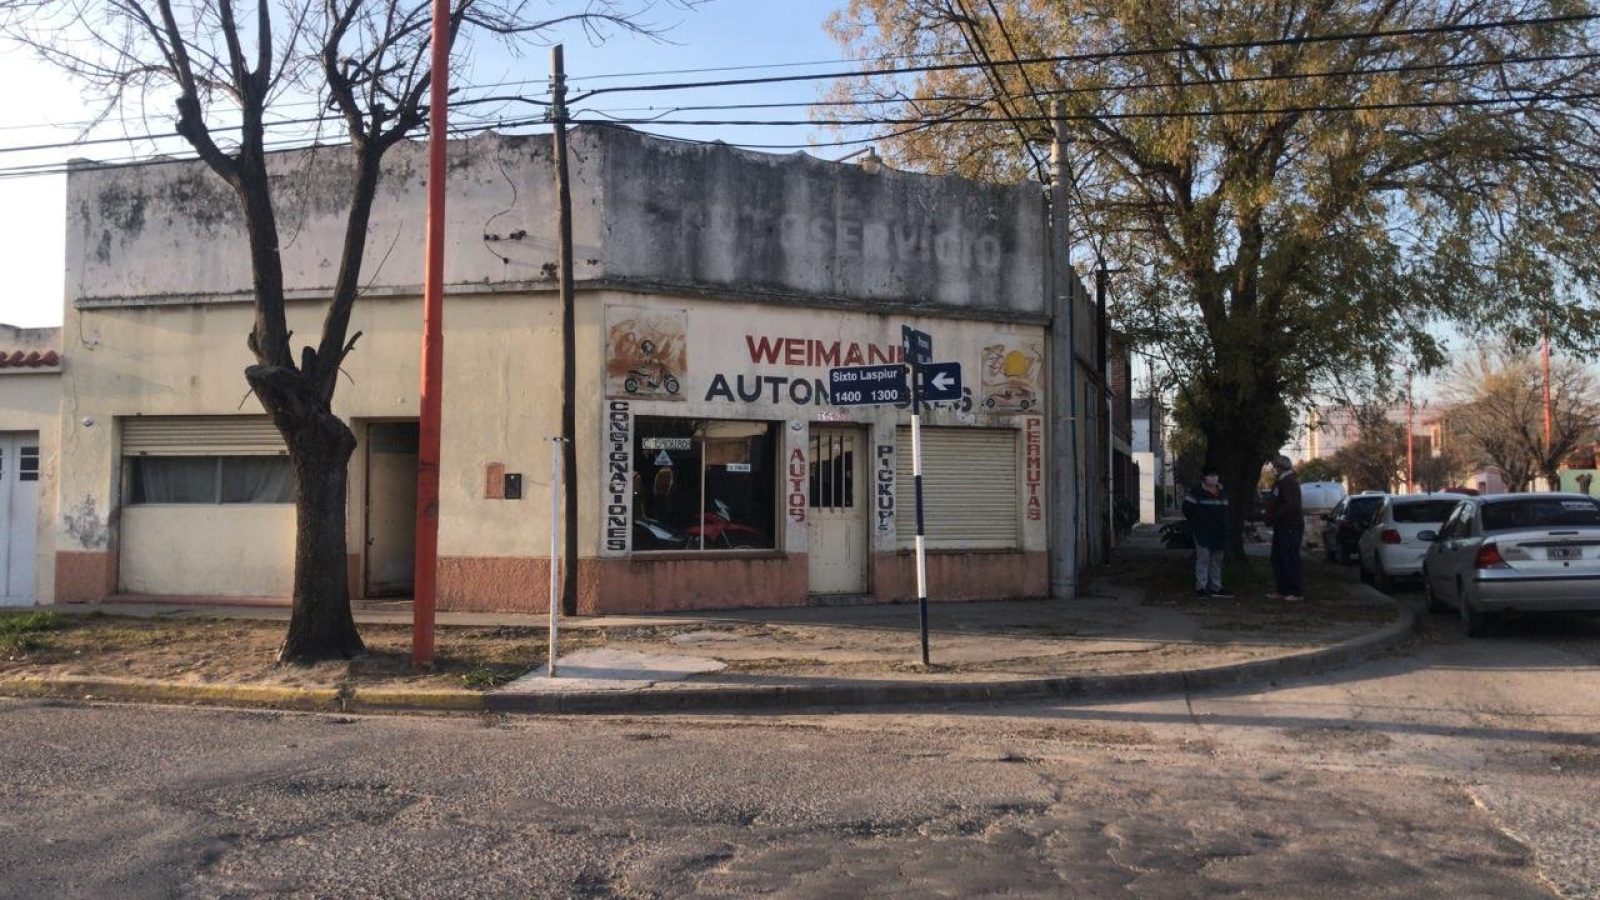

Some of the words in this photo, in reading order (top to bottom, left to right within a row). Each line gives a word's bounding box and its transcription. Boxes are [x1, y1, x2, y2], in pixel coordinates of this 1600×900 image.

[832, 370, 857, 382] Sixto
[860, 369, 898, 382] Laspiur
[834, 391, 862, 403] 1400
[871, 389, 899, 401] 1300
[608, 401, 629, 551] CONSIGNACIONES
[789, 448, 806, 522] AUTOS
[1027, 418, 1041, 521] PERMUTAS
